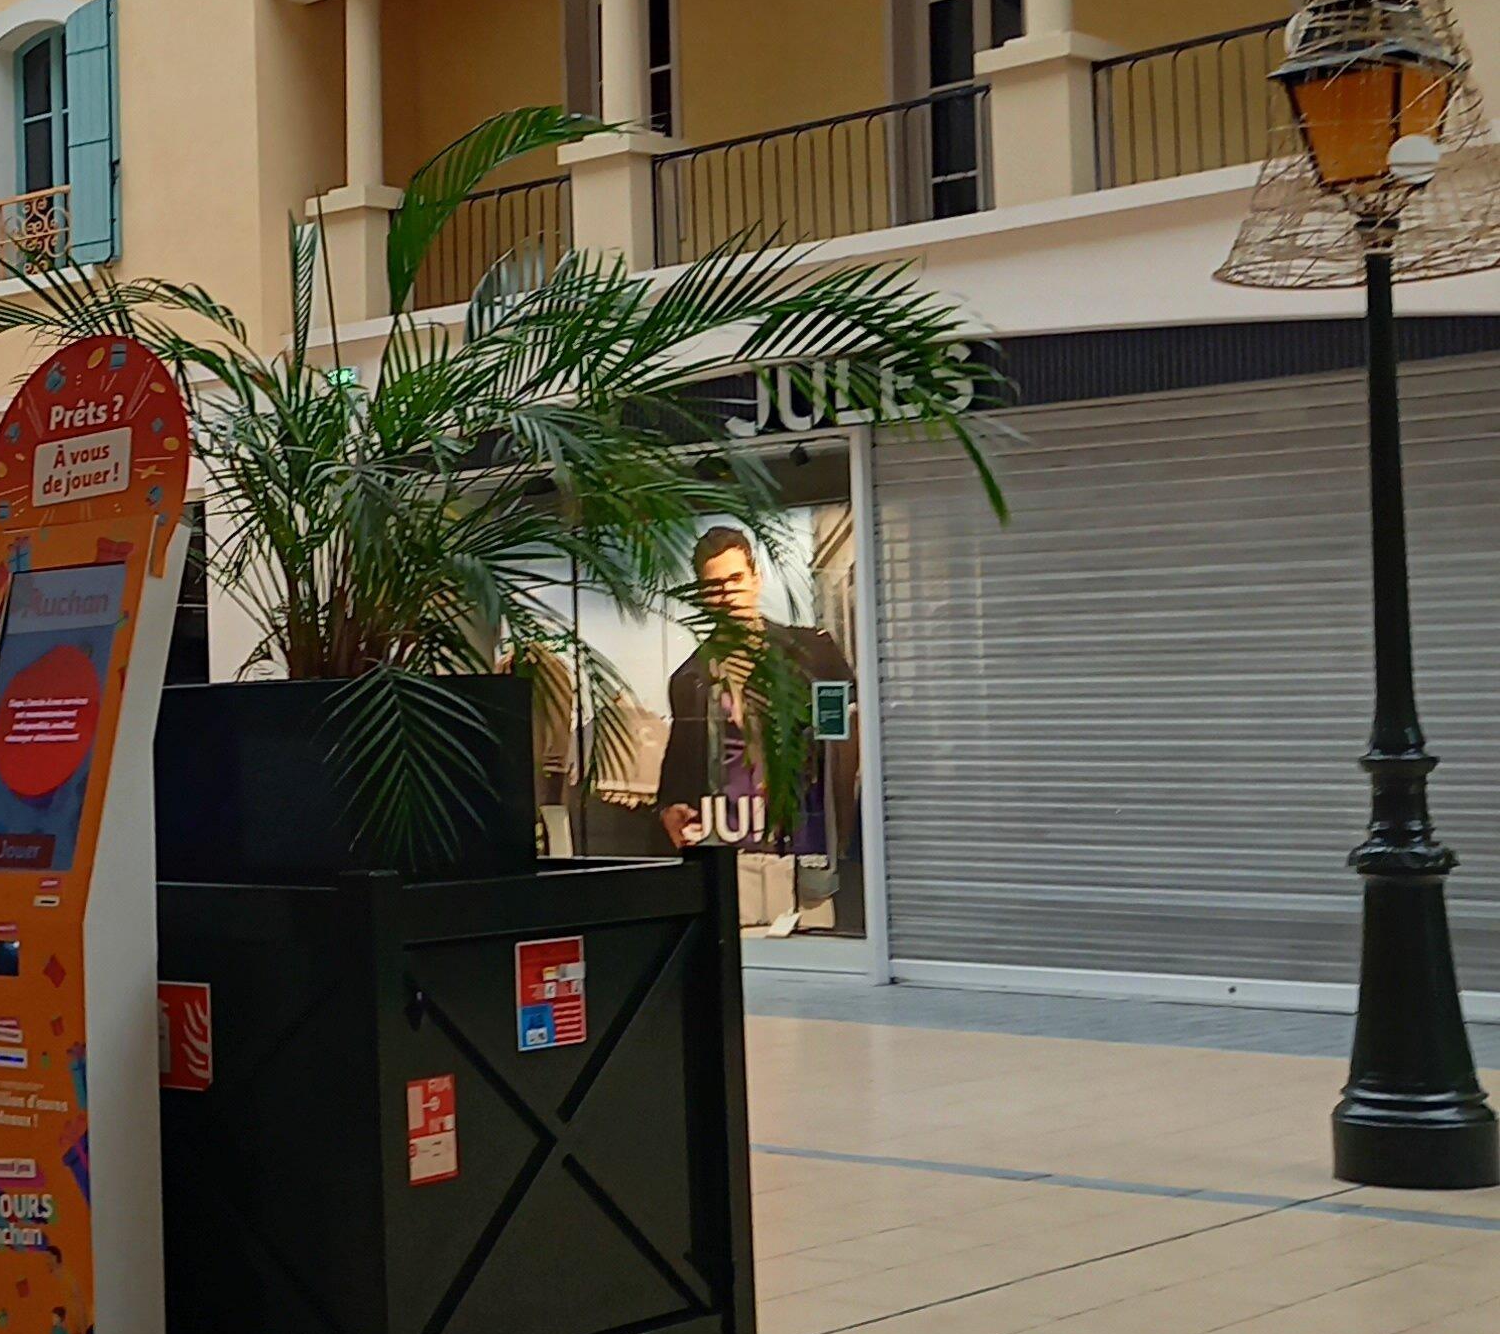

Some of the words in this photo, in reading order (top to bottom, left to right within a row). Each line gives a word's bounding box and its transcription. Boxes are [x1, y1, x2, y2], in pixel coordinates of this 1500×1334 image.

[725, 343, 975, 437] JULES
[48, 398, 109, 431] Prêts
[112, 394, 124, 422] ?
[53, 444, 66, 469] À
[70, 444, 110, 466] vous
[42, 474, 63, 495] de
[64, 469, 112, 498] jouer
[112, 461, 120, 483] !
[19, 587, 109, 620] Auchan
